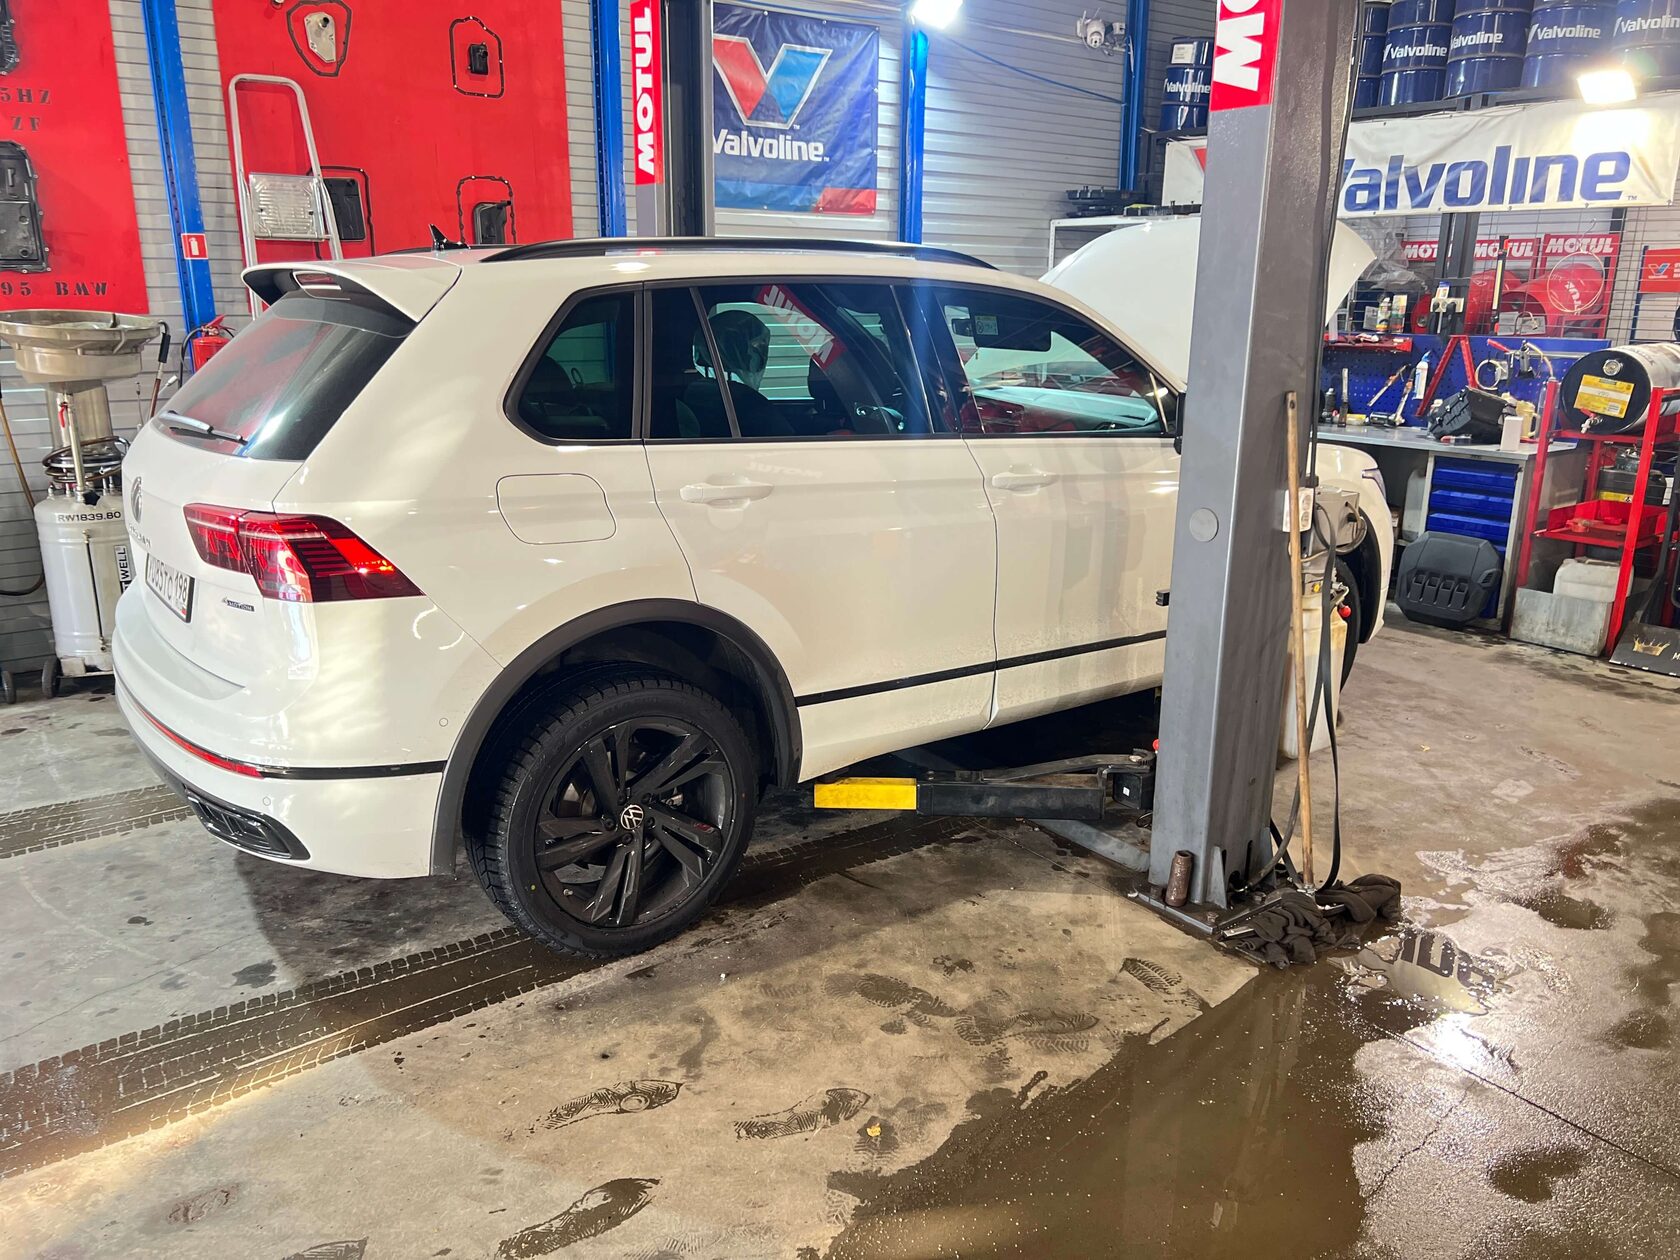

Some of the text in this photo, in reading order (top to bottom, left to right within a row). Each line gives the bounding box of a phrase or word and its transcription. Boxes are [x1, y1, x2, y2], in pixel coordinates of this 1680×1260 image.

[1537, 24, 1601, 41] Valvoline
[1212, 0, 1265, 92] M
[1390, 43, 1448, 59] Valvoline
[634, 6, 655, 176] MOTUL
[1166, 81, 1211, 93] Valvoline
[712, 129, 824, 162] Valvoline
[1405, 243, 1446, 259] MOT
[1545, 237, 1614, 254] MOTUL
[55, 281, 107, 296] BMW
[57, 511, 122, 522] RW1839.80
